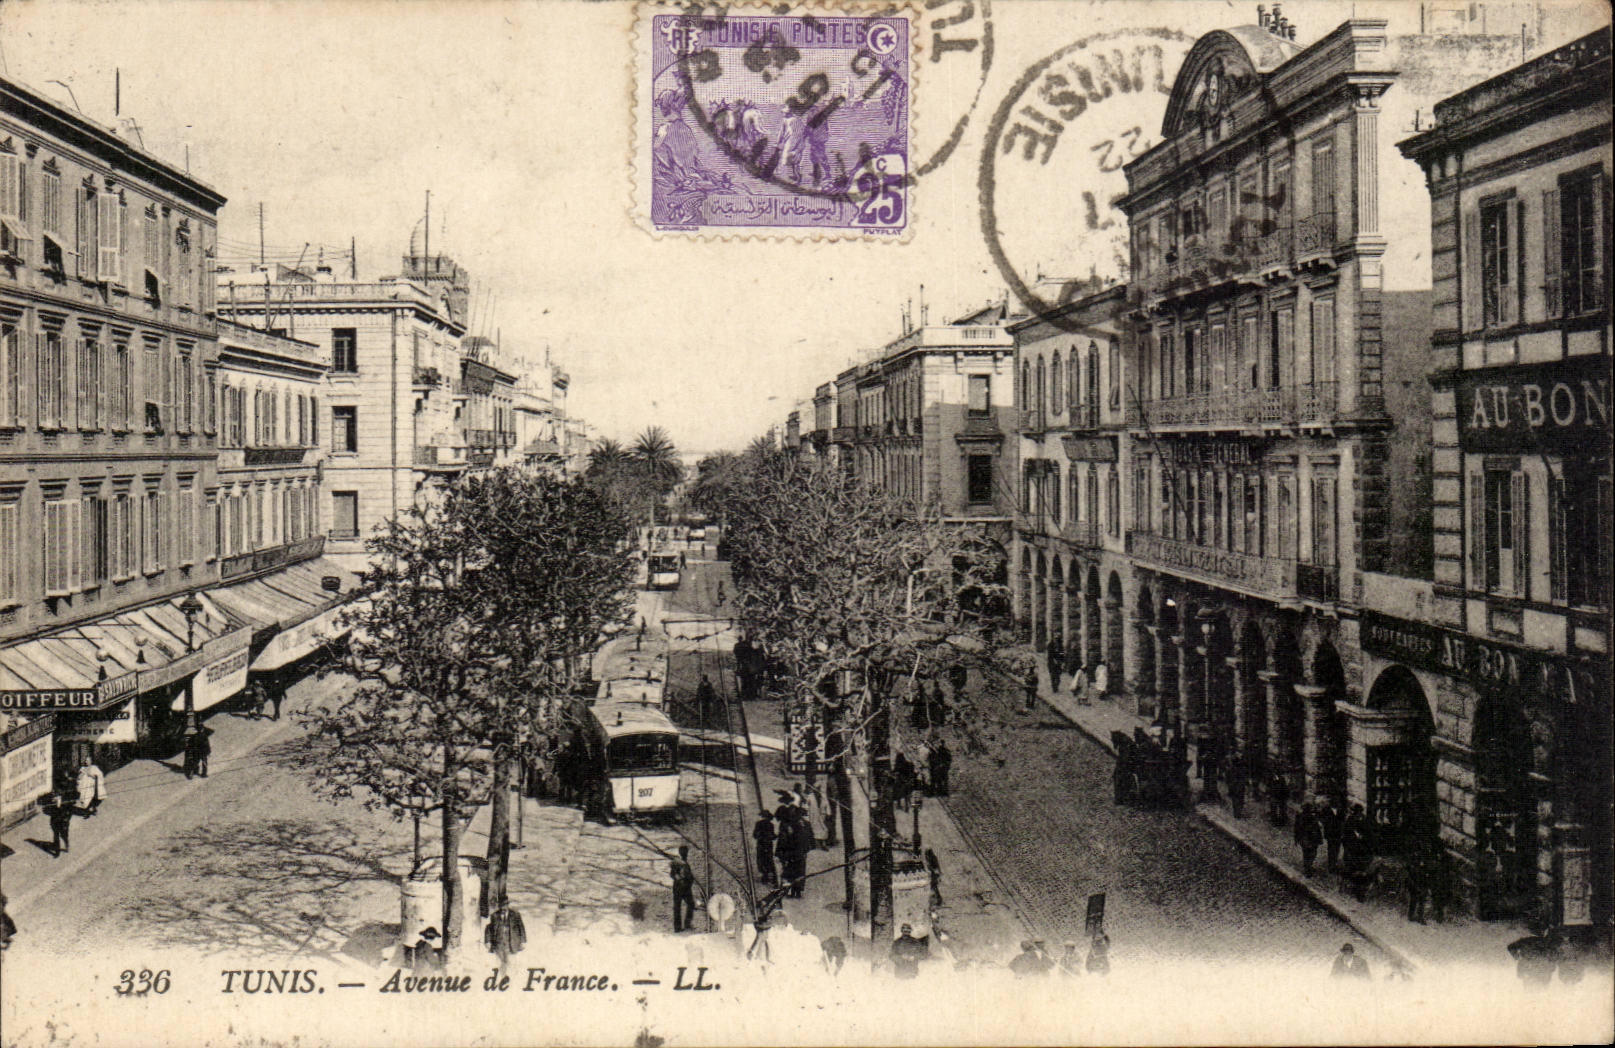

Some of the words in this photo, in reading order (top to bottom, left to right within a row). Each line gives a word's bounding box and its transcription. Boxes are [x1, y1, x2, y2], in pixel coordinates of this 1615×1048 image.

[672, 27, 695, 48] RF
[702, 22, 781, 44] TUNISIE
[792, 23, 868, 45] POSTES
[857, 172, 903, 225] 25
[1468, 386, 1509, 428] AU
[1523, 381, 1610, 426] BON
[2, 692, 95, 707] OIFFEUR
